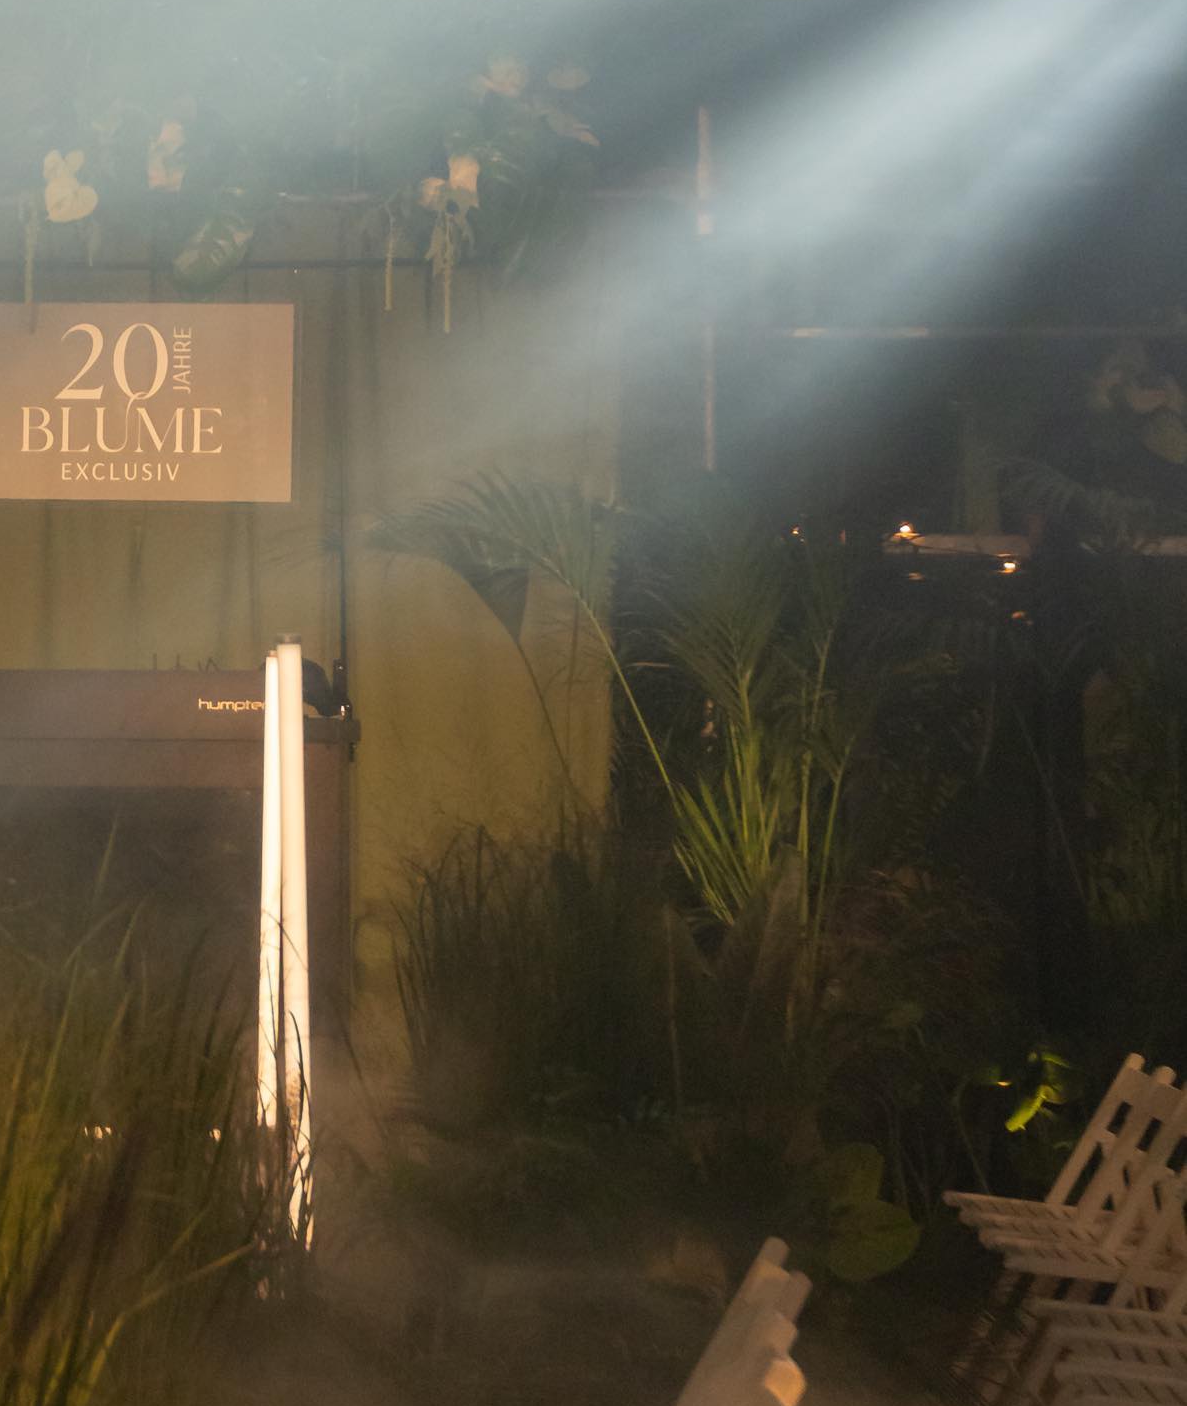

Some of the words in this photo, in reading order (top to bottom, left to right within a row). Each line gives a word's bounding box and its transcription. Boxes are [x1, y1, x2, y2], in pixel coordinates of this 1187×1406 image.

[54, 322, 169, 401] 20
[173, 325, 192, 394] JAHRE
[20, 406, 223, 454] BLUME
[61, 462, 180, 482] EXCLUSIV
